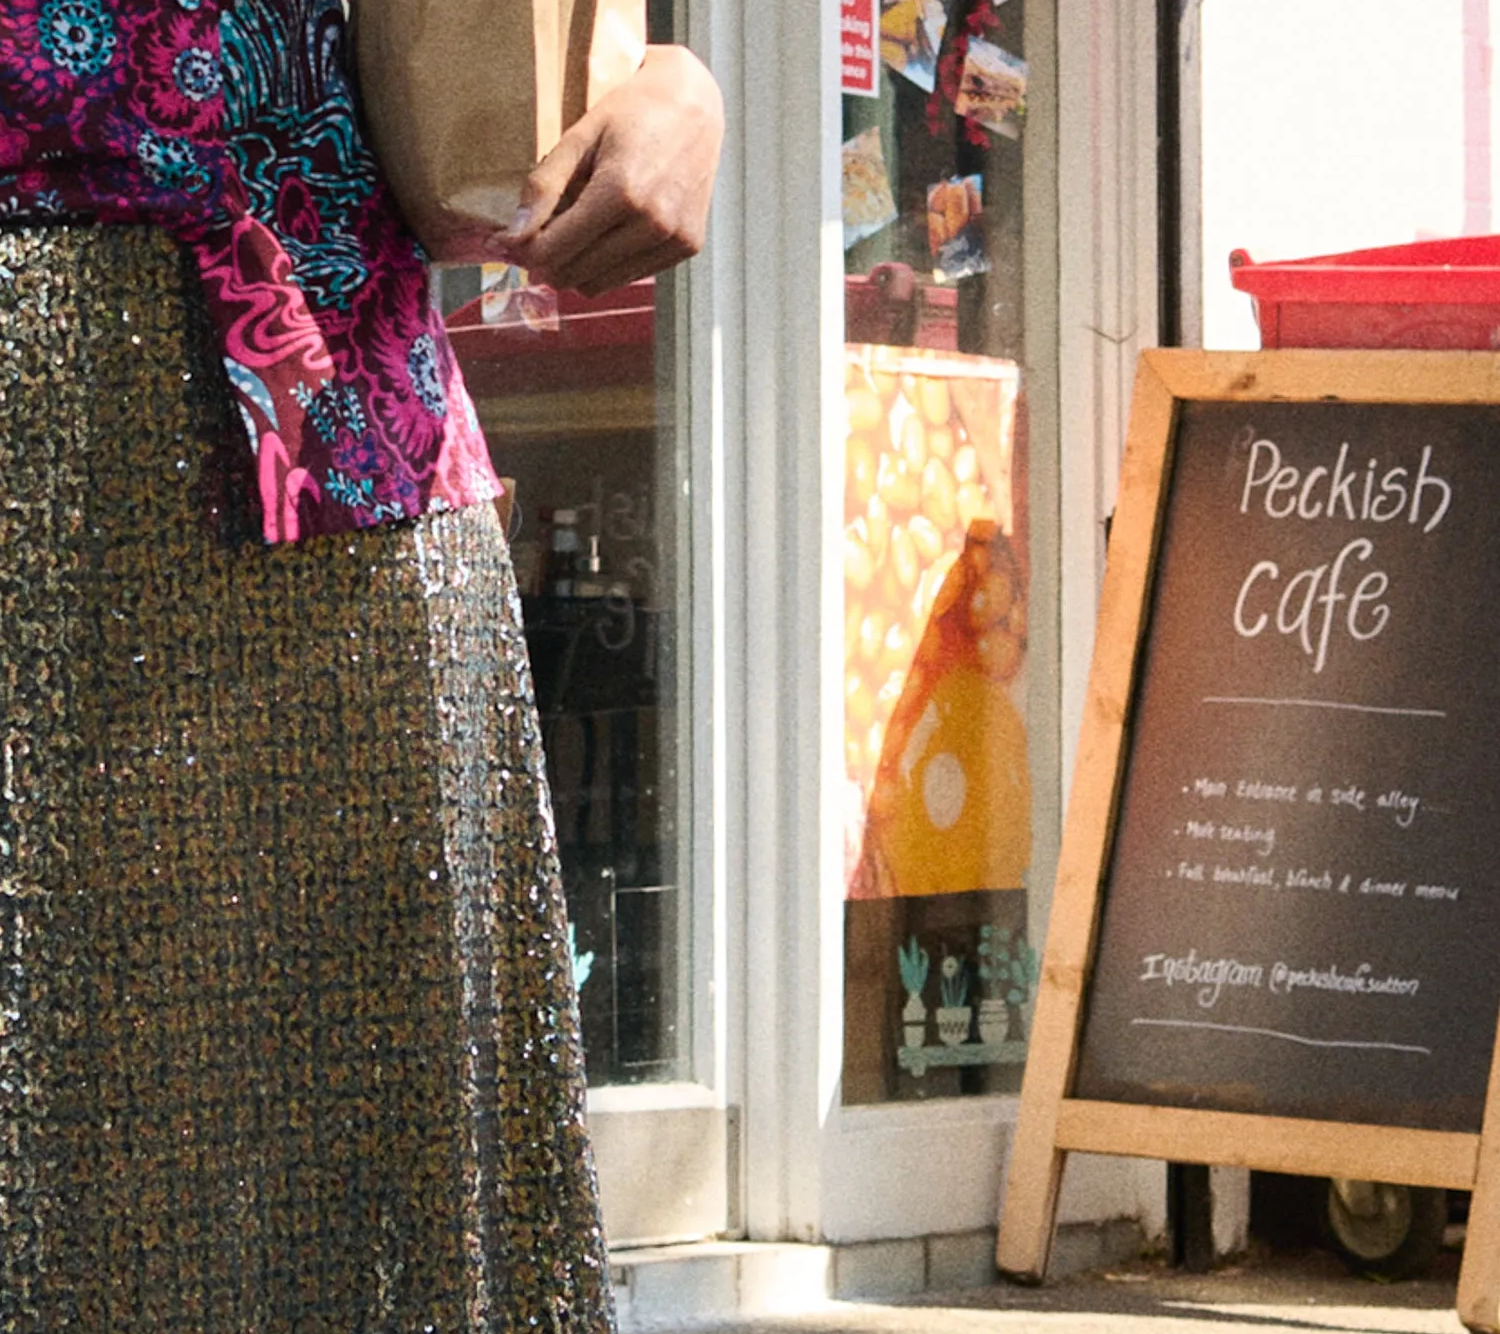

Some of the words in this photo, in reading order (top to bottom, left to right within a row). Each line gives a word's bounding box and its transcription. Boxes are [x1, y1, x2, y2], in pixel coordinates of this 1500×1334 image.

[1239, 438, 1453, 534] Peckish
[1331, 783, 1366, 811] side
[1140, 948, 1266, 1009] Instagram
